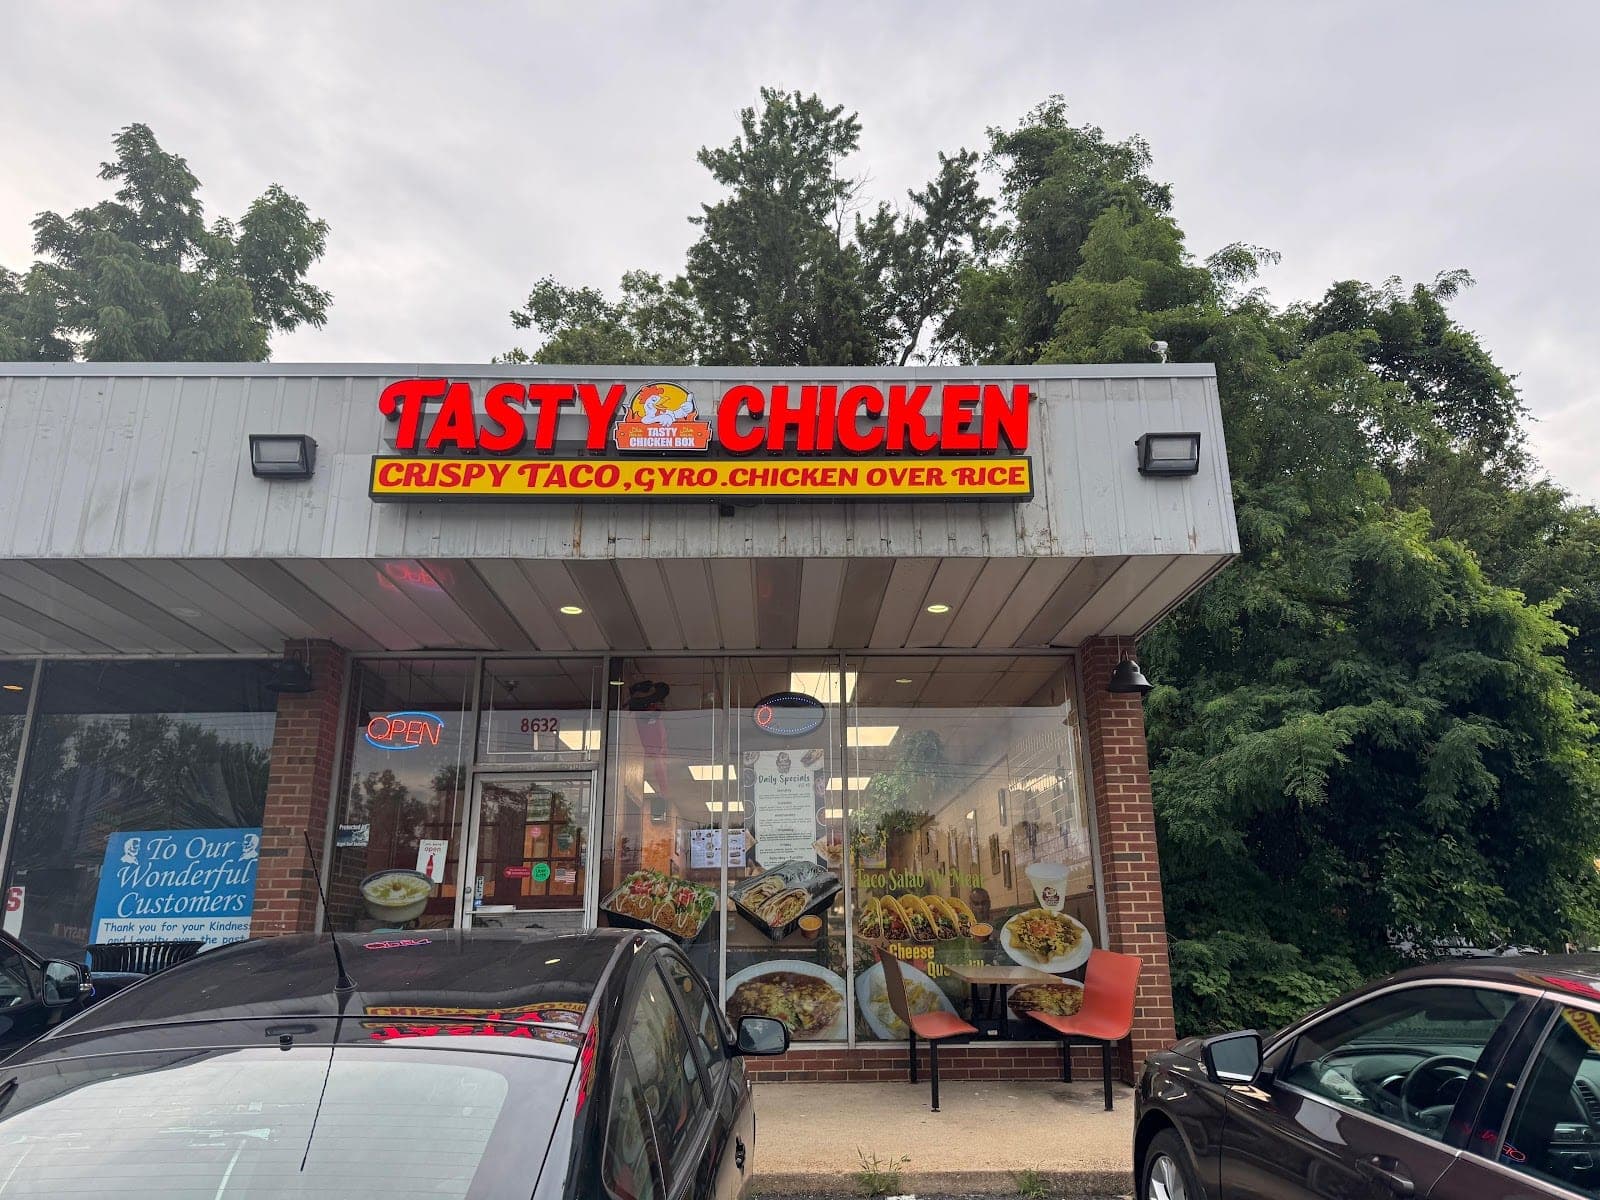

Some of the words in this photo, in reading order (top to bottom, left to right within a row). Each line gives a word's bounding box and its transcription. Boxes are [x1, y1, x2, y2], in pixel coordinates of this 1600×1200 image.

[378, 379, 627, 452] TASTY
[717, 384, 1031, 453] CHICKEN
[647, 427, 678, 437] TASTY
[629, 437, 671, 448] CHICKEN
[674, 437, 695, 447] BOX
[378, 462, 510, 488] CRISPY
[866, 466, 947, 487] OVER
[951, 465, 1026, 487] RICE
[367, 716, 441, 745] OPEN
[520, 717, 558, 733] 8632
[758, 774, 777, 785] Daily
[779, 772, 810, 785] Specials
[146, 836, 177, 860] To
[185, 836, 236, 860] Our
[117, 859, 258, 894] Wonderful
[855, 868, 886, 888] Taco
[117, 891, 247, 918] Customers
[104, 922, 134, 932] Thank
[138, 923, 156, 935] you
[161, 921, 178, 932] for
[182, 922, 205, 934] your
[209, 920, 252, 931] Kindnes
[201, 935, 217, 944] the
[889, 943, 935, 960] Cheese
